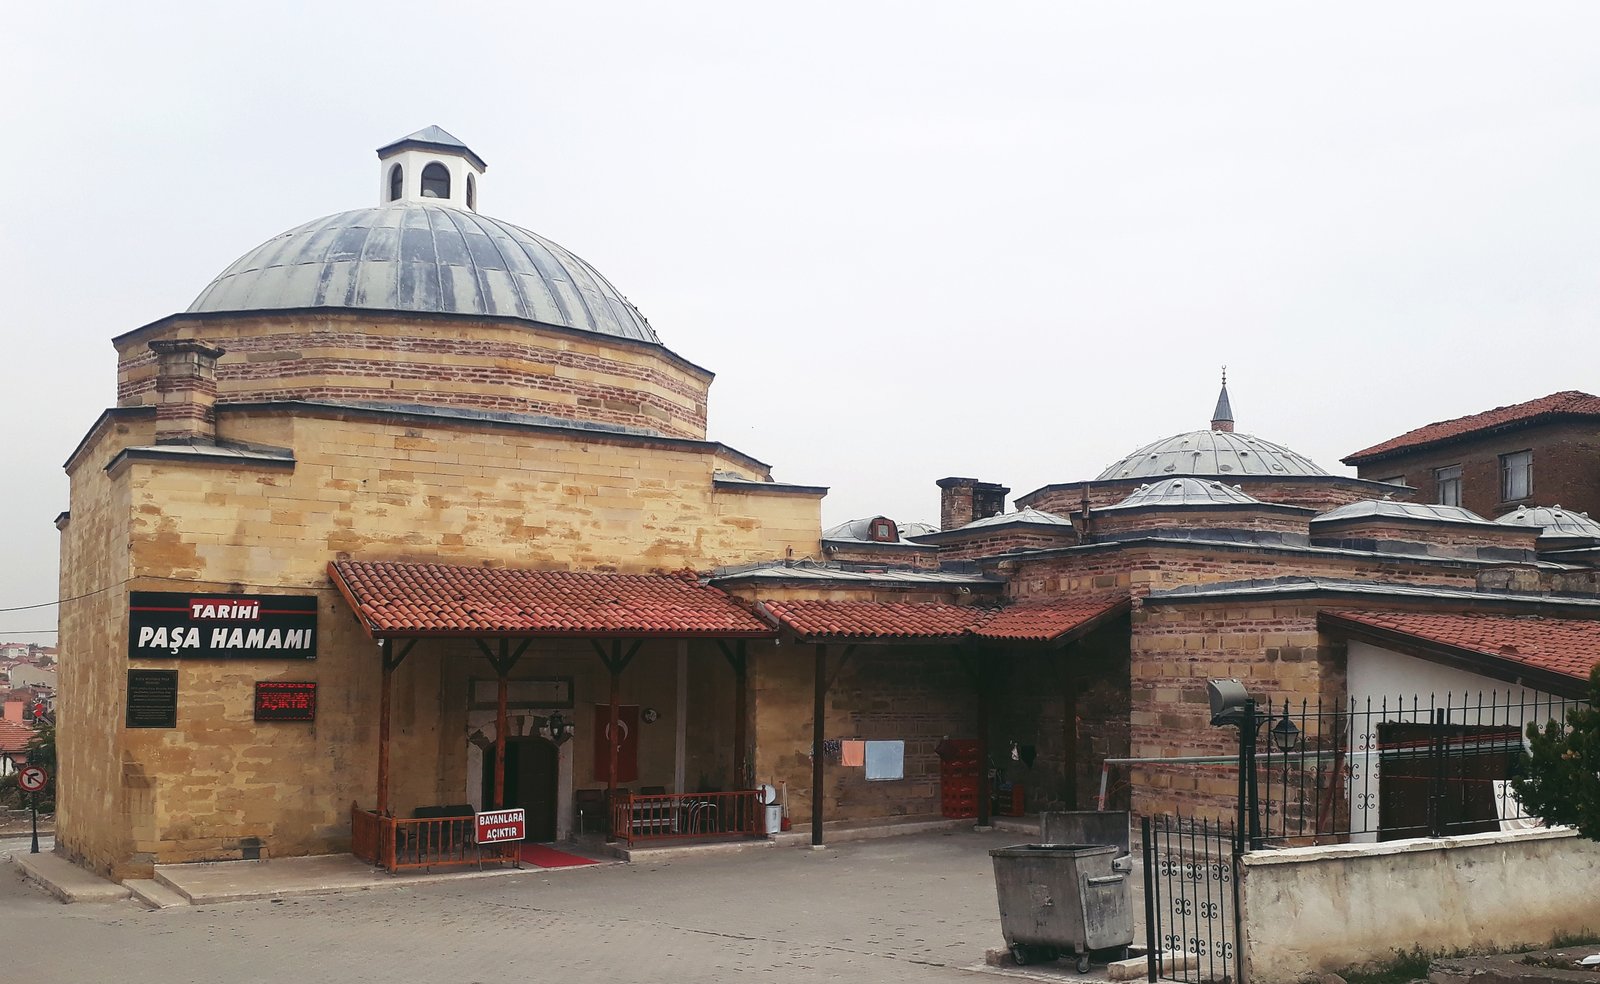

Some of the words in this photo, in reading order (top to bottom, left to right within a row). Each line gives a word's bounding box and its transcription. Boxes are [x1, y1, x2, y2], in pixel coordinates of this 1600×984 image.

[191, 600, 259, 619] TARİHİ
[138, 626, 200, 654] PAŞA
[210, 628, 312, 649] HAMAMI
[479, 812, 523, 826] BAYANLARA
[486, 827, 517, 841] AÇIKTIR
